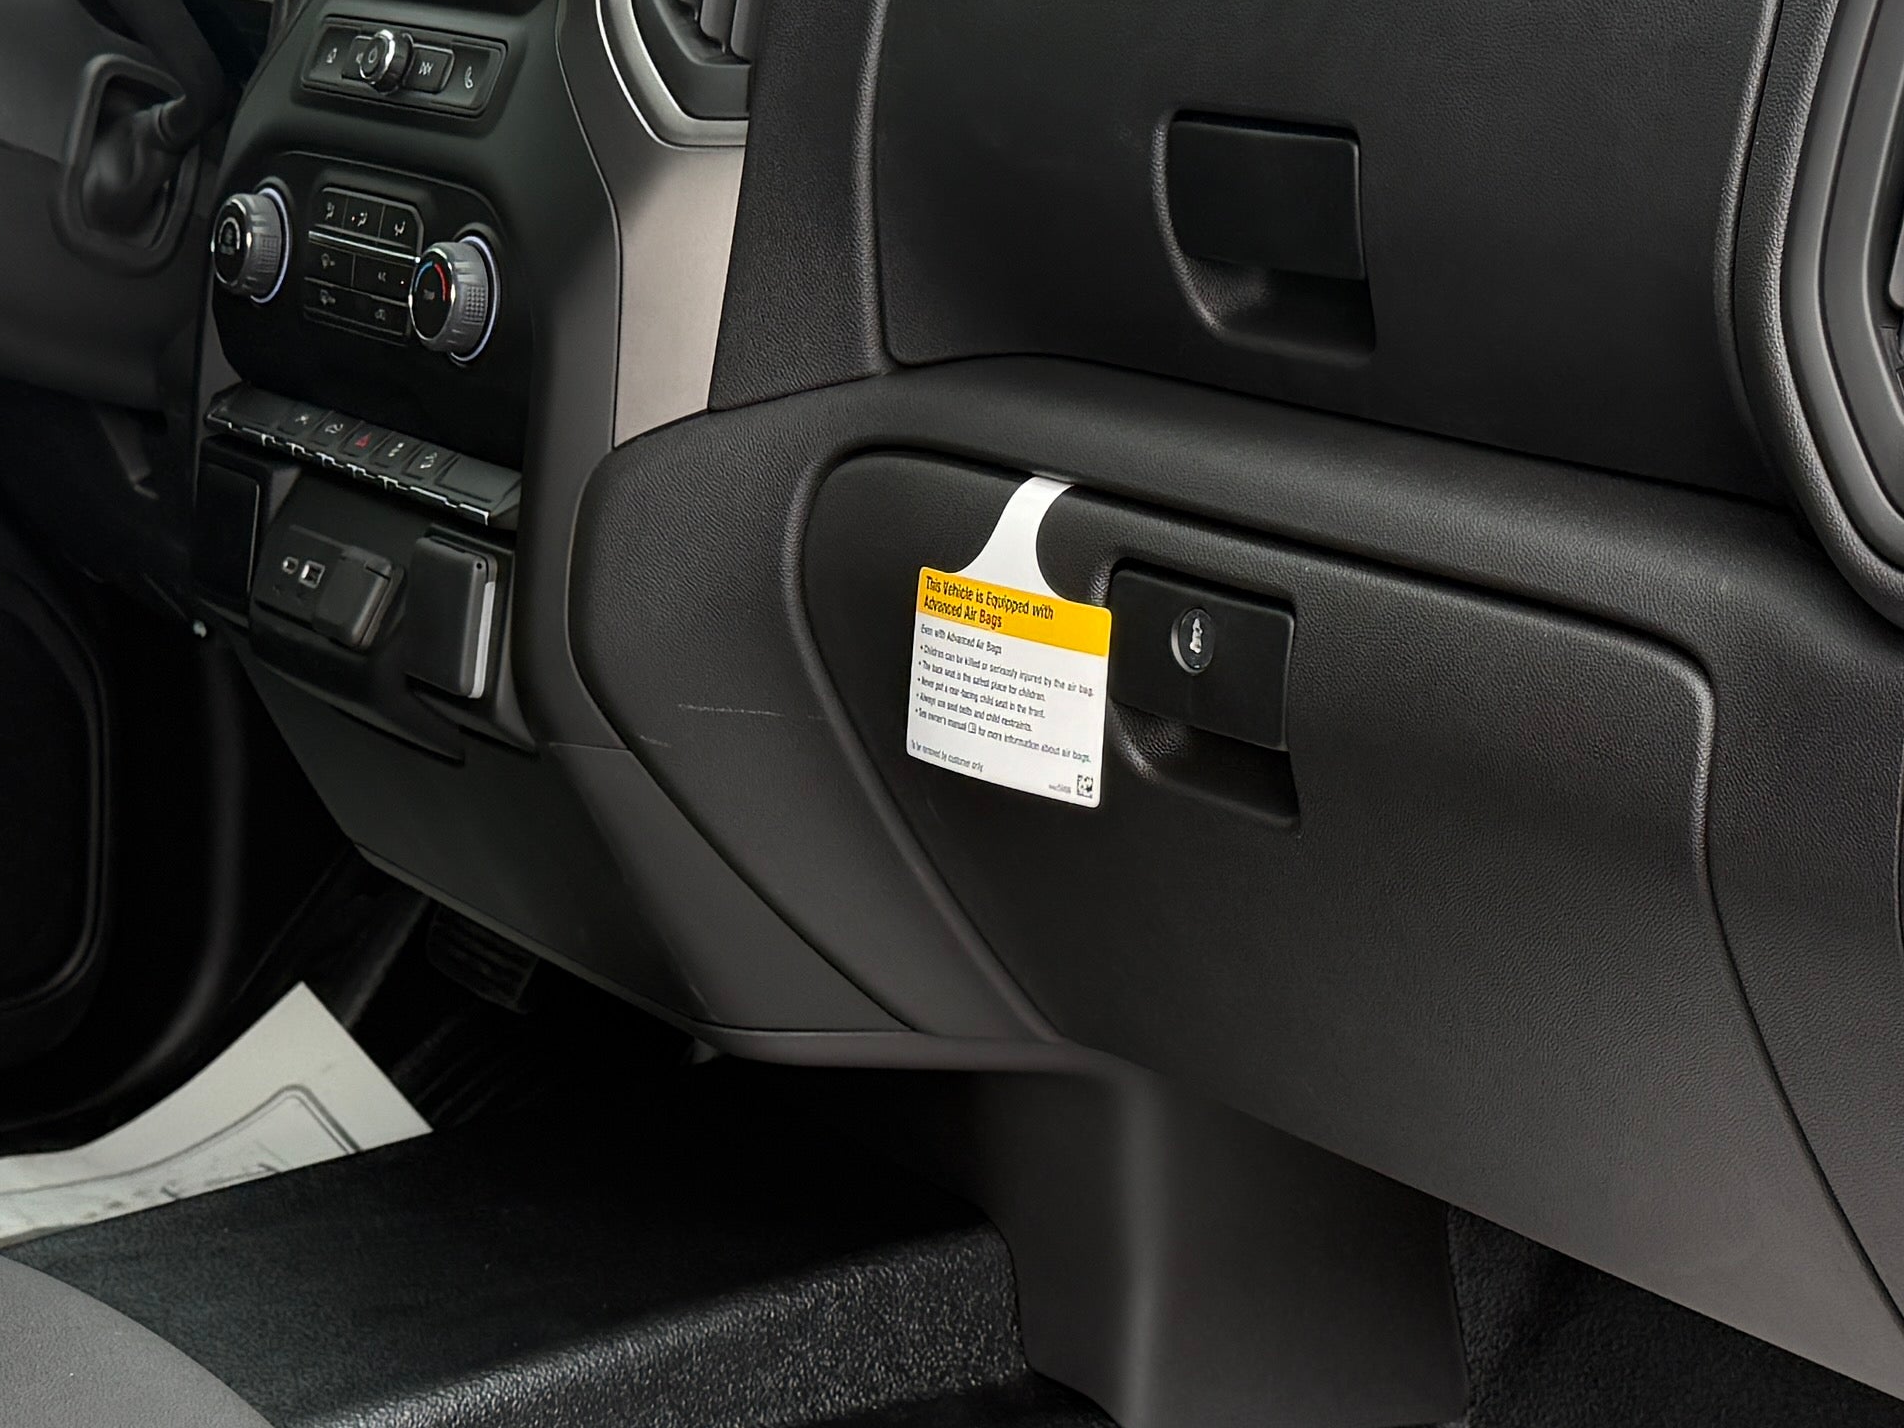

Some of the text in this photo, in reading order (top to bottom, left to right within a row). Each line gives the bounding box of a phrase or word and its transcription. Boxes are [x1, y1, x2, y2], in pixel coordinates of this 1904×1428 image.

[926, 575, 1054, 620] This Vehicle is Equipped with
[924, 595, 1002, 630] Advanced Air Bags
[947, 631, 975, 648] Advanced
[986, 641, 1002, 655] Bags
[989, 664, 1018, 679] seriously
[1019, 669, 1042, 684] injured
[1004, 734, 1040, 750] information
